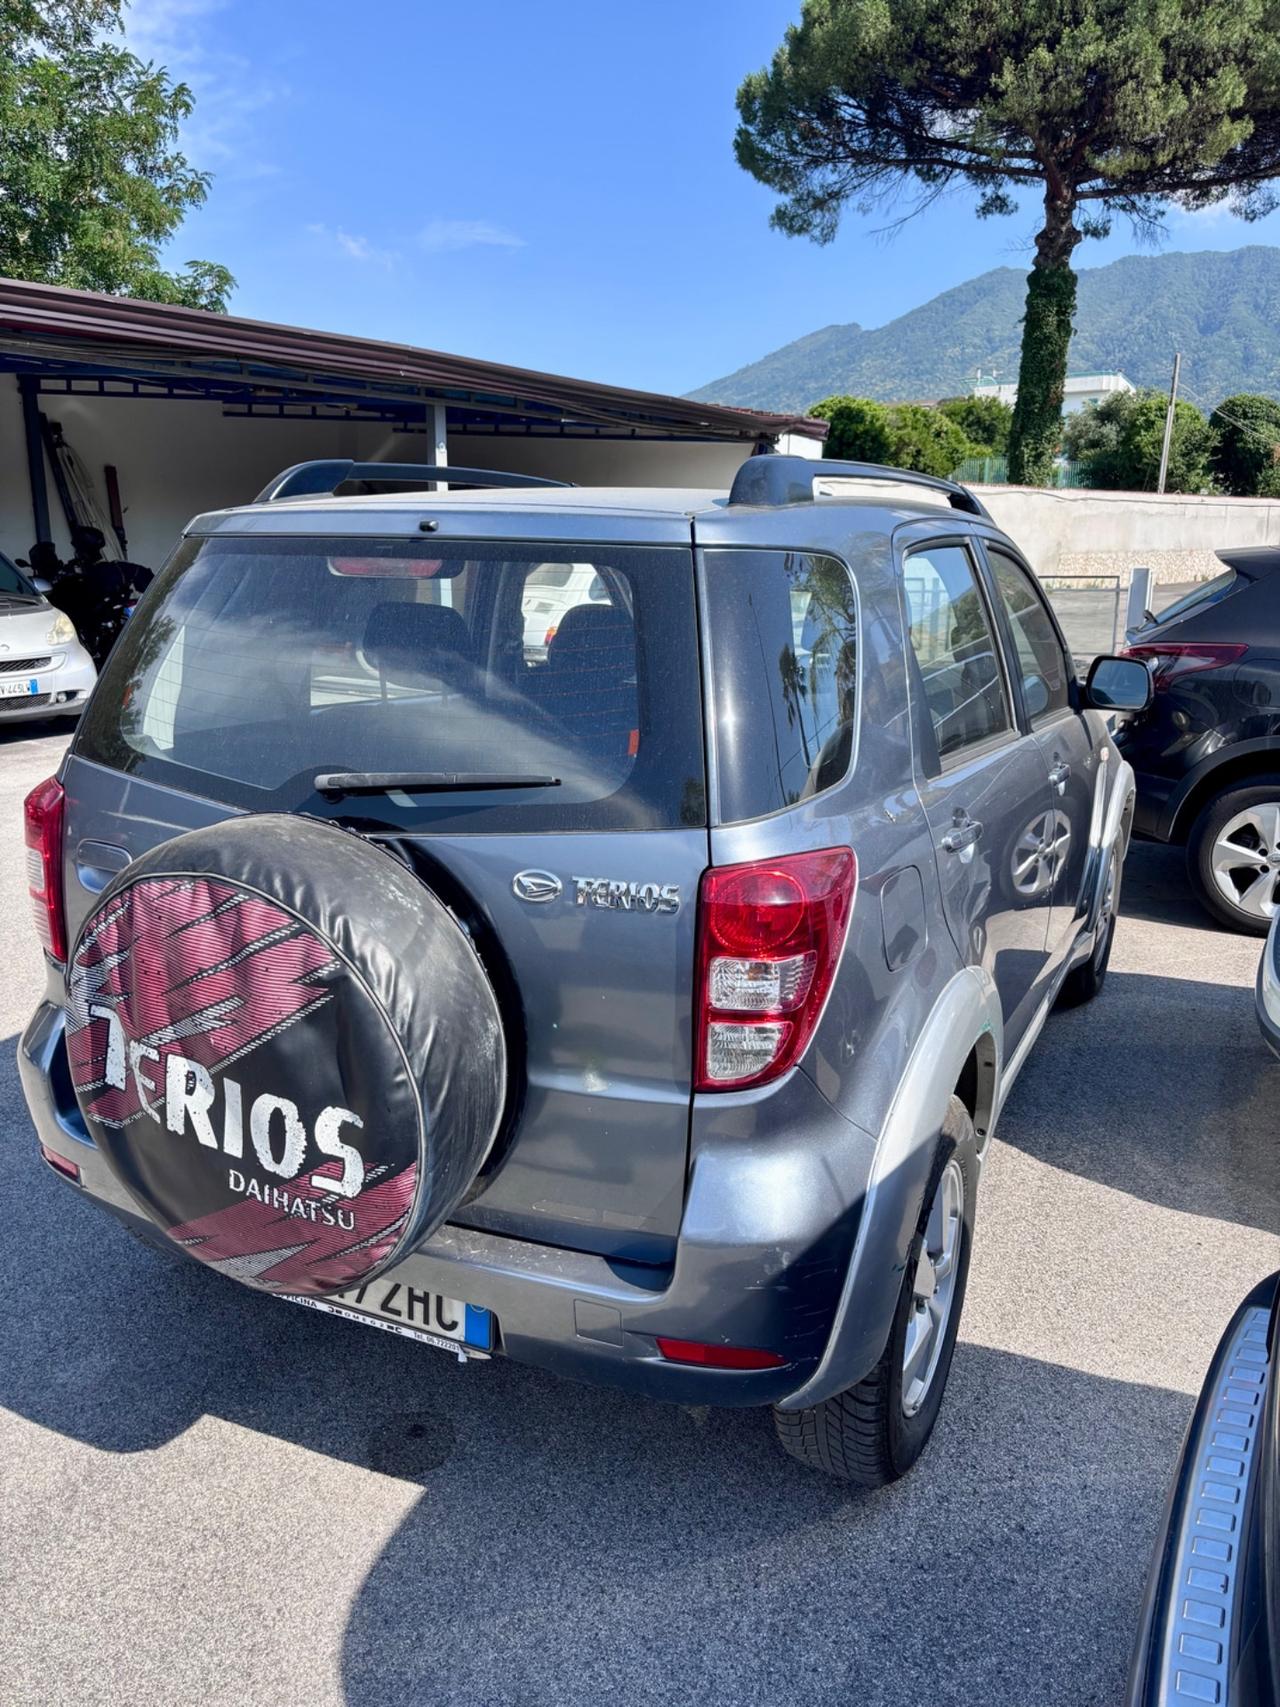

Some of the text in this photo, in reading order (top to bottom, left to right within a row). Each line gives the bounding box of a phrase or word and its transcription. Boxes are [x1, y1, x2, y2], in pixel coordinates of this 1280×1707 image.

[571, 875, 681, 914] TERIOS
[90, 1003, 365, 1199] TERIOS
[228, 1168, 356, 1231] DAIHATSU
